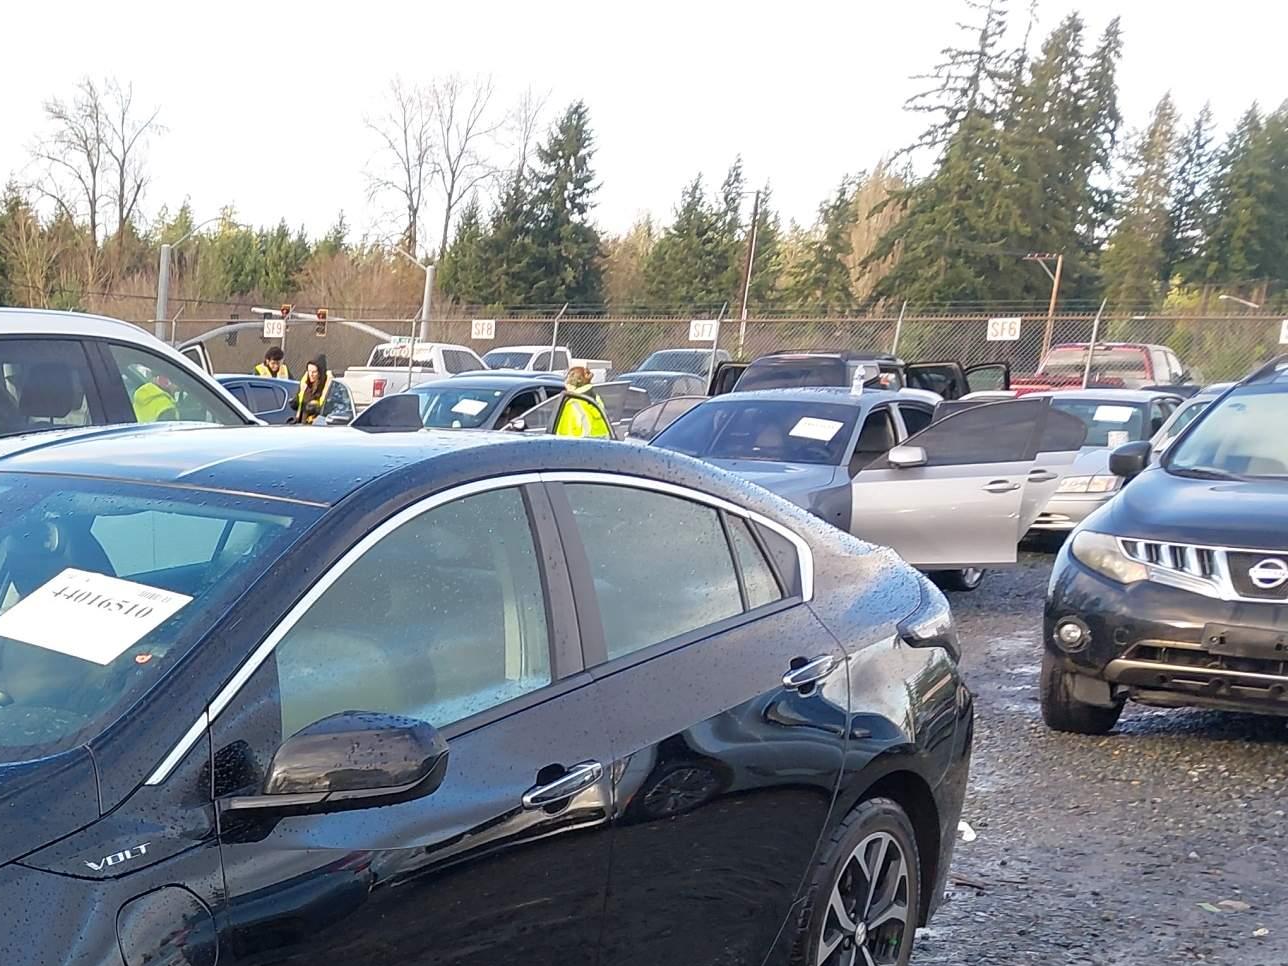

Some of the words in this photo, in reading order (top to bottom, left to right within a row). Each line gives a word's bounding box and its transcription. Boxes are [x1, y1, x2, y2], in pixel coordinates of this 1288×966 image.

[266, 321, 283, 336] SF9
[693, 322, 714, 338] SF7
[991, 320, 1018, 338] SF6
[51, 585, 154, 620] 44016510
[83, 841, 152, 871] VOLT
